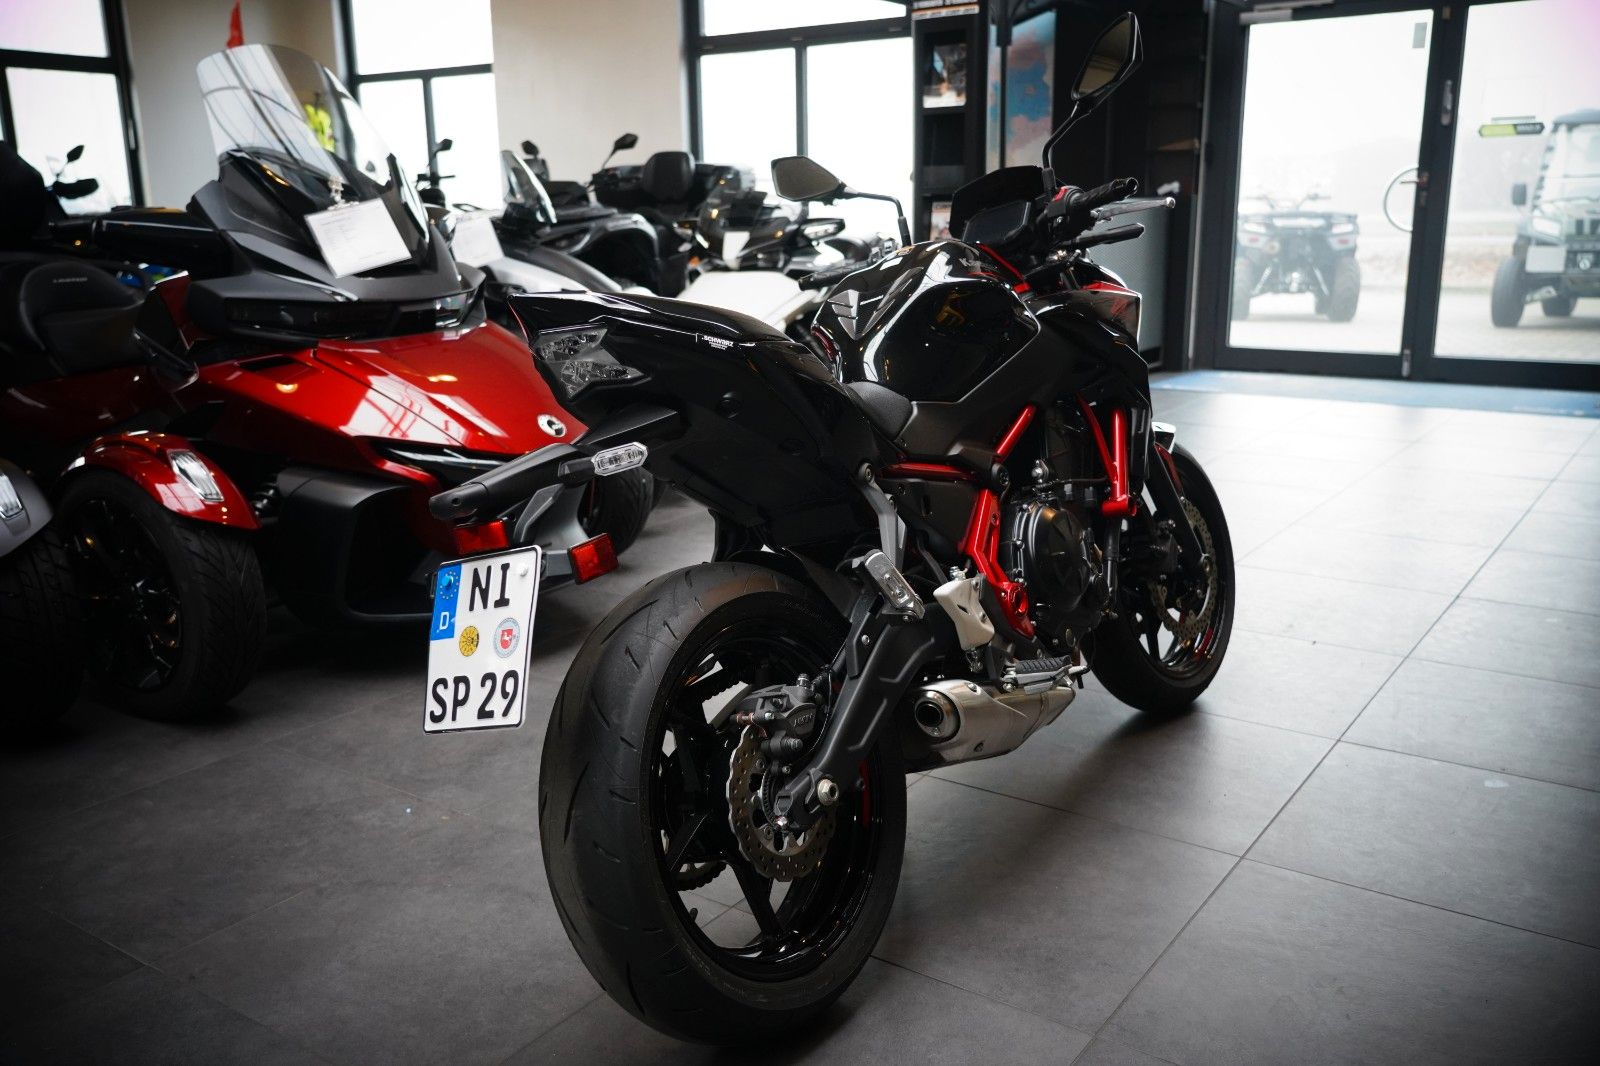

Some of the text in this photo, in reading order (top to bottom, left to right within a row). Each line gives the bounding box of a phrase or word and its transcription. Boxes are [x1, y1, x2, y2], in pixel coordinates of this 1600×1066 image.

[469, 563, 511, 611] NI
[439, 611, 450, 631] D
[429, 669, 519, 723] SP 29
